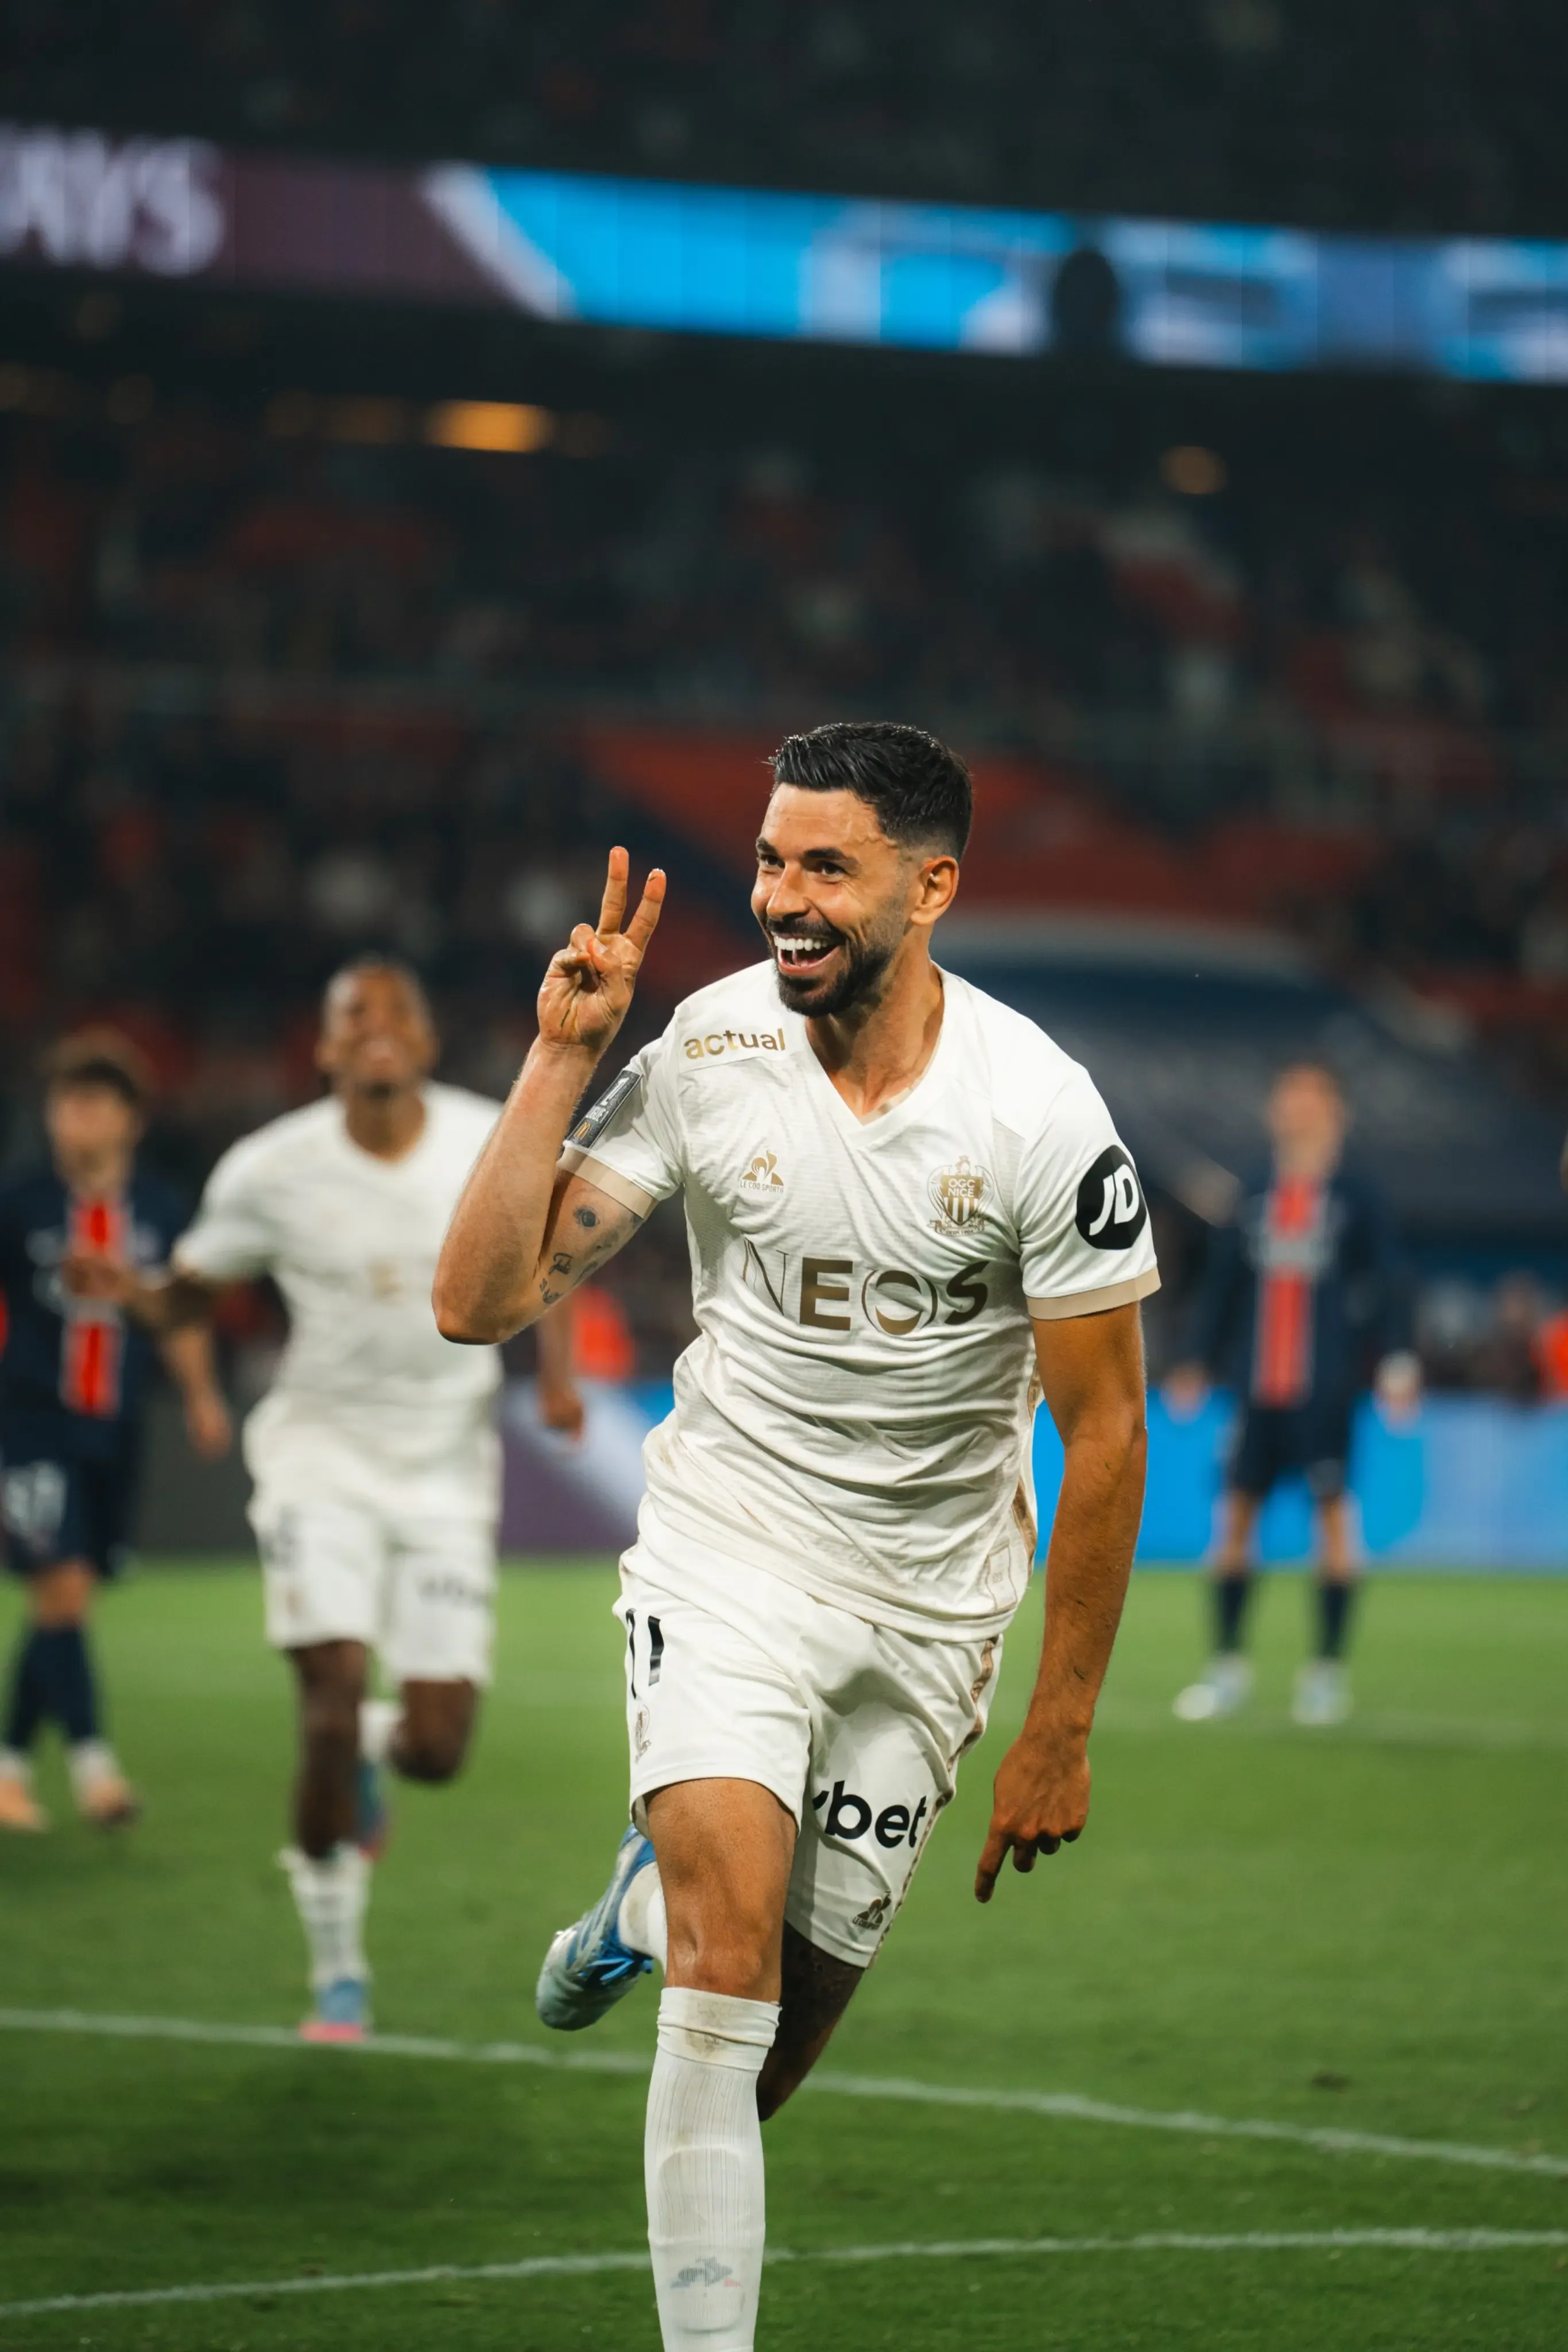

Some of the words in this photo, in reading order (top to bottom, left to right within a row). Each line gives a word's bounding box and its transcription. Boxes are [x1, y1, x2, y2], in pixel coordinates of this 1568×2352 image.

[684, 1028, 785, 1059] actual
[948, 1178, 975, 1188] OGC
[948, 1188, 974, 1197] NICE
[1089, 1164, 1139, 1236] JD
